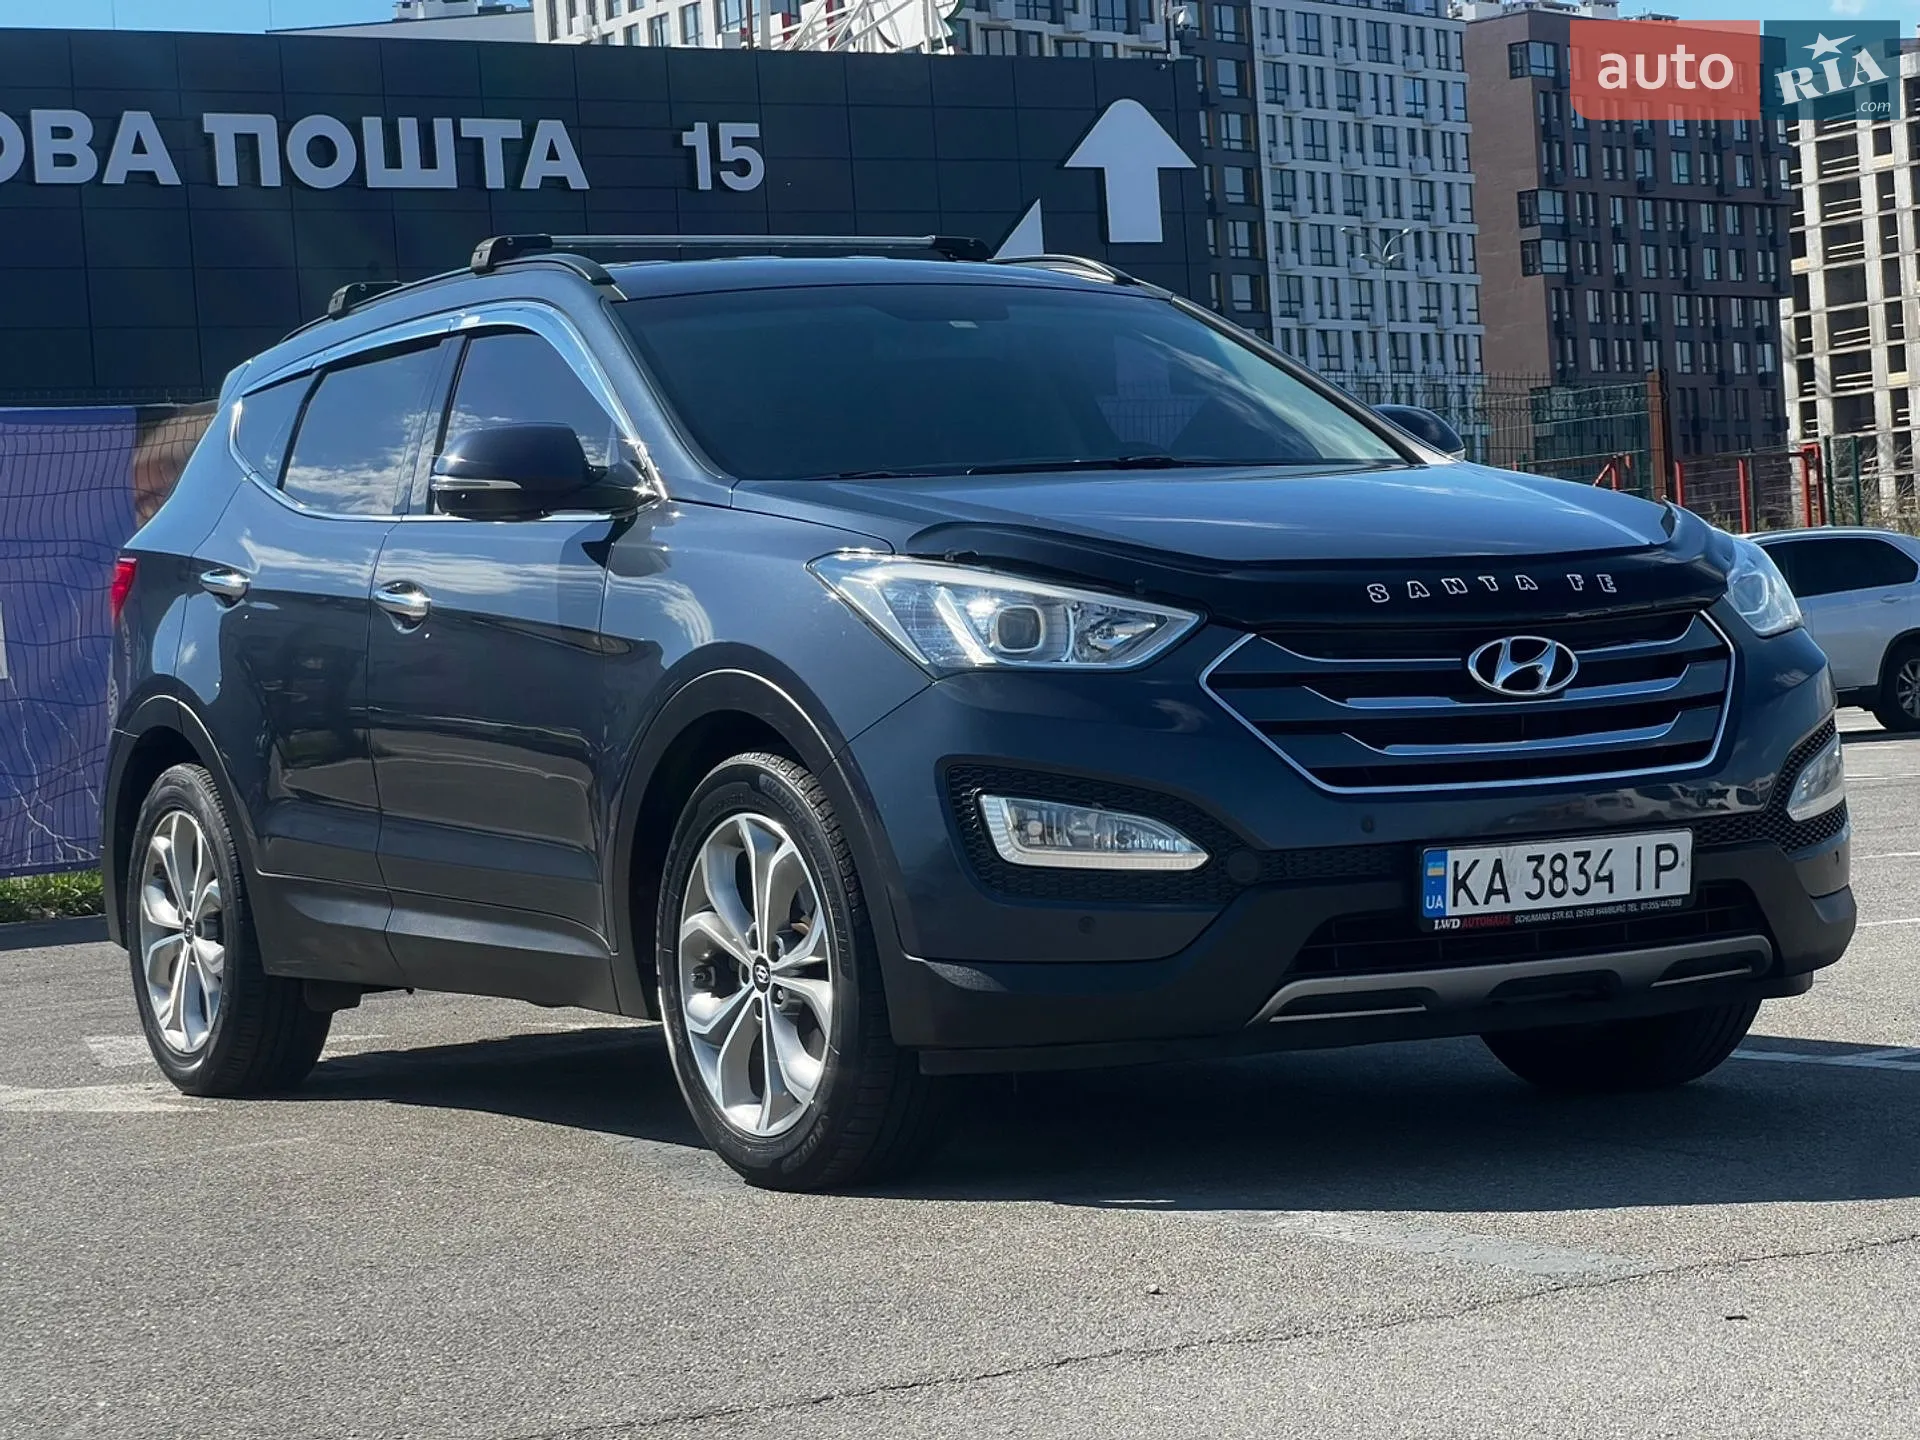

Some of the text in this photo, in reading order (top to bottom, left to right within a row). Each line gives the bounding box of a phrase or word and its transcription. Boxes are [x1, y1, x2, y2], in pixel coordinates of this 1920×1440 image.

[203, 112, 591, 191] ПОШТА
[681, 121, 766, 191] 15
[1366, 573, 1618, 604] SANTA FE
[1451, 842, 1680, 907] KA 3834 IP
[1425, 894, 1445, 910] UA
